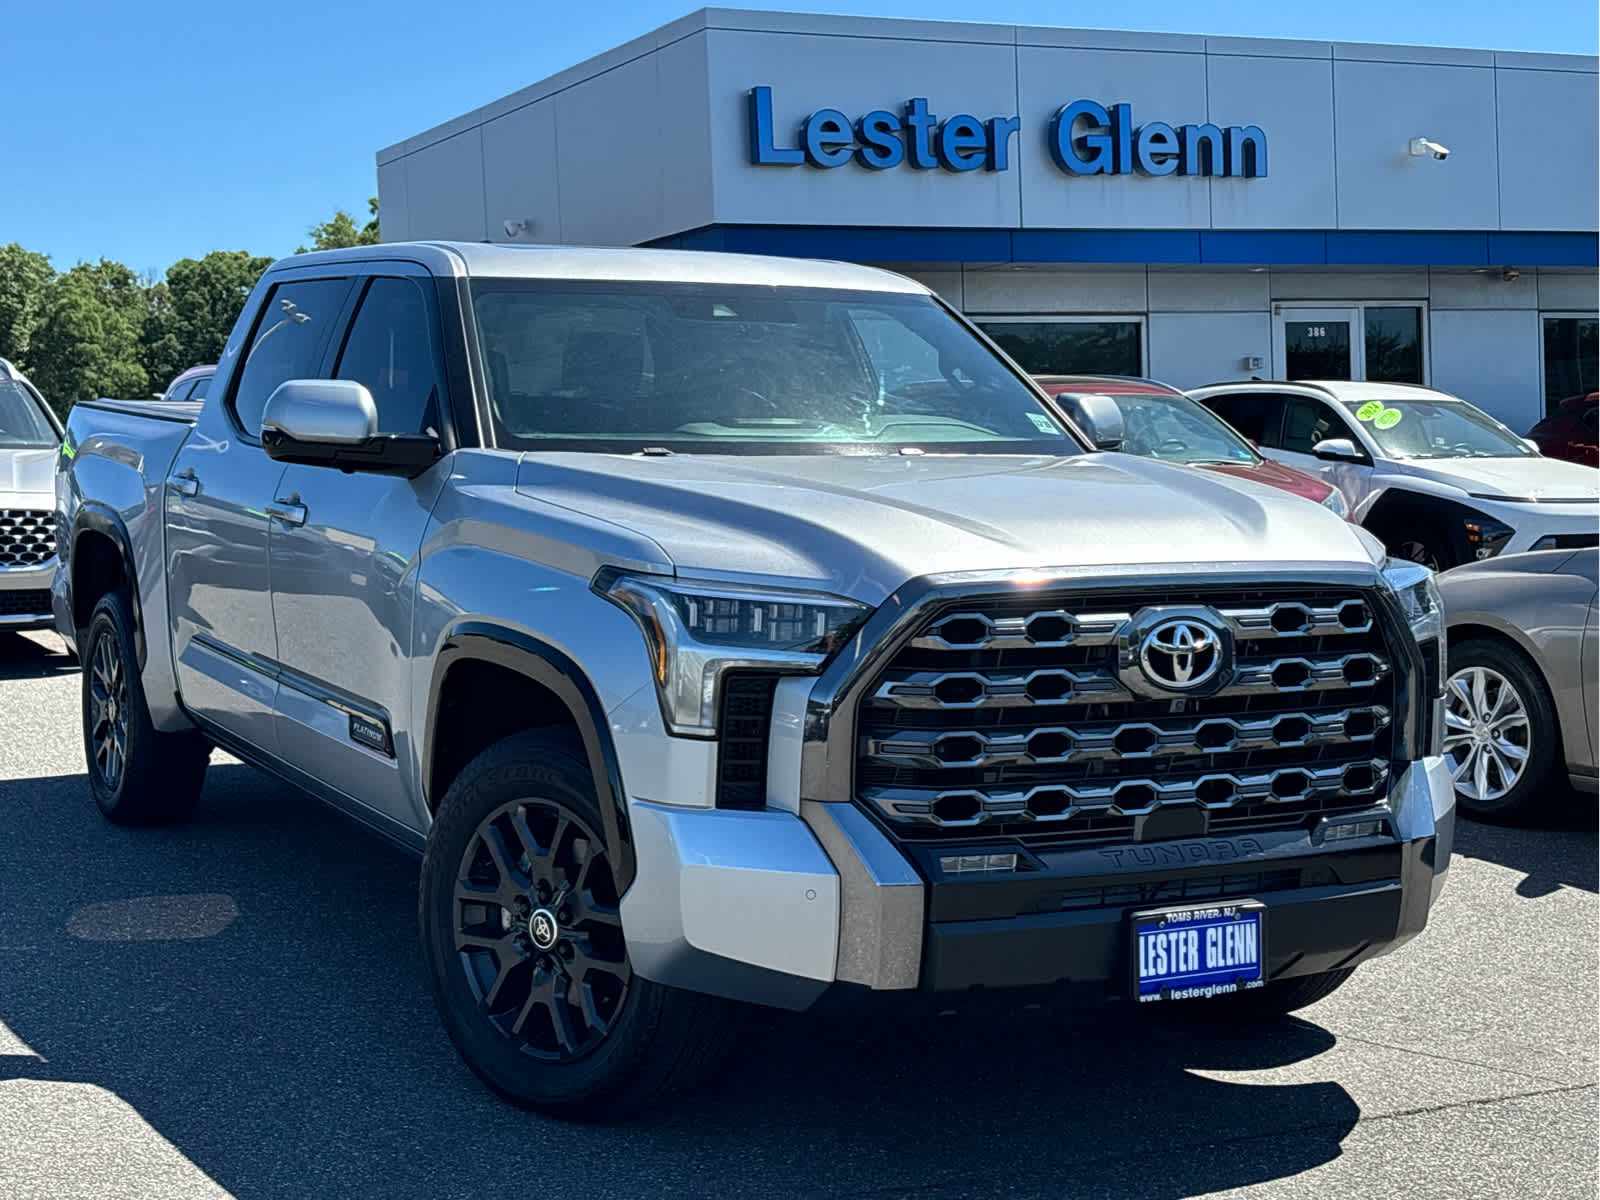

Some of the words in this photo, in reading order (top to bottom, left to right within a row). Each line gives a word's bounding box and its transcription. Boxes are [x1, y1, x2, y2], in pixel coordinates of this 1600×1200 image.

[748, 86, 1020, 172] Lester
[1049, 99, 1268, 178] Glenn
[1308, 327, 1326, 337] 386
[1099, 838, 1265, 869] TUNDRA
[1166, 911, 1192, 923] TOMS
[1224, 907, 1236, 917] NJ
[1139, 930, 1199, 978] LESTER
[1206, 923, 1257, 969] GLENN
[1171, 983, 1237, 1000] lesterglenn
